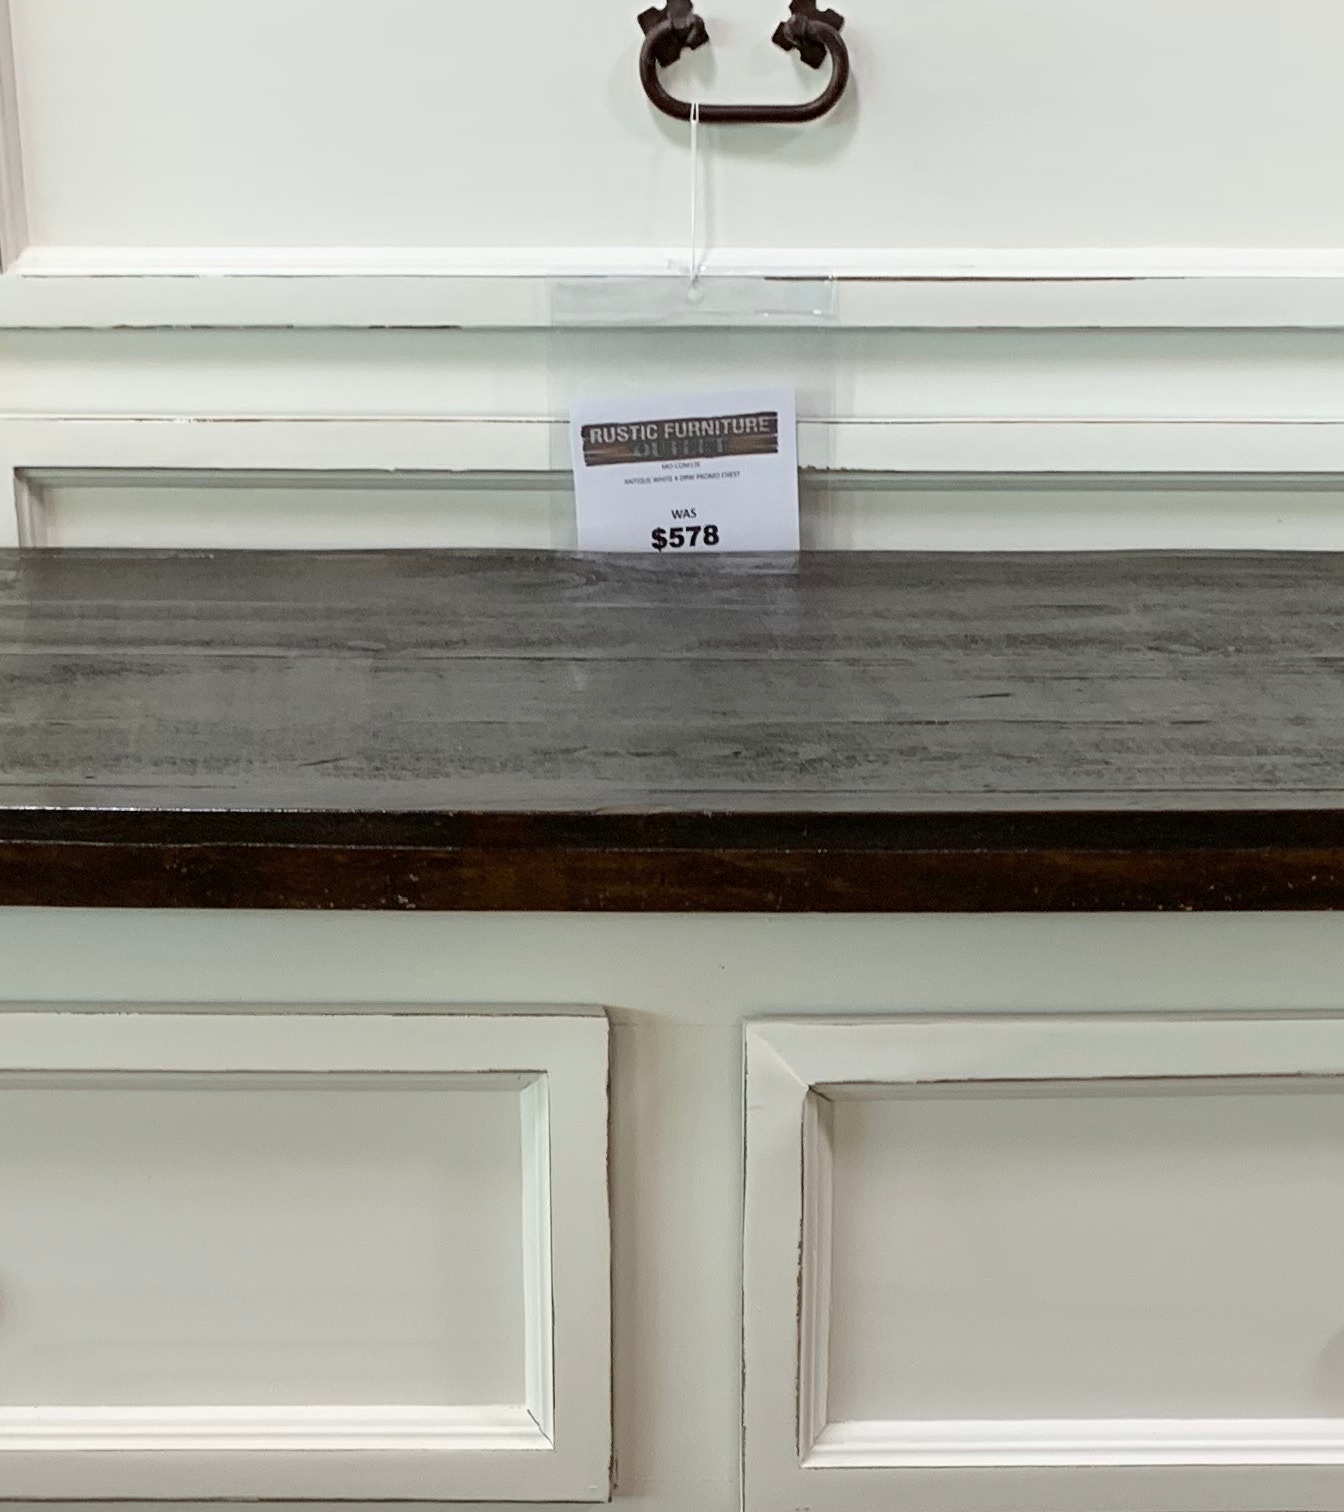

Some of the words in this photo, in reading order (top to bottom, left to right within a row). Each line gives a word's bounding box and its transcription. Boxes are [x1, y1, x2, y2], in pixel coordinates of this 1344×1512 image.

[589, 424, 658, 444] RUSTIC
[664, 416, 770, 439] FURNITURE
[671, 508, 697, 519] WAS
[651, 524, 719, 552] $578
